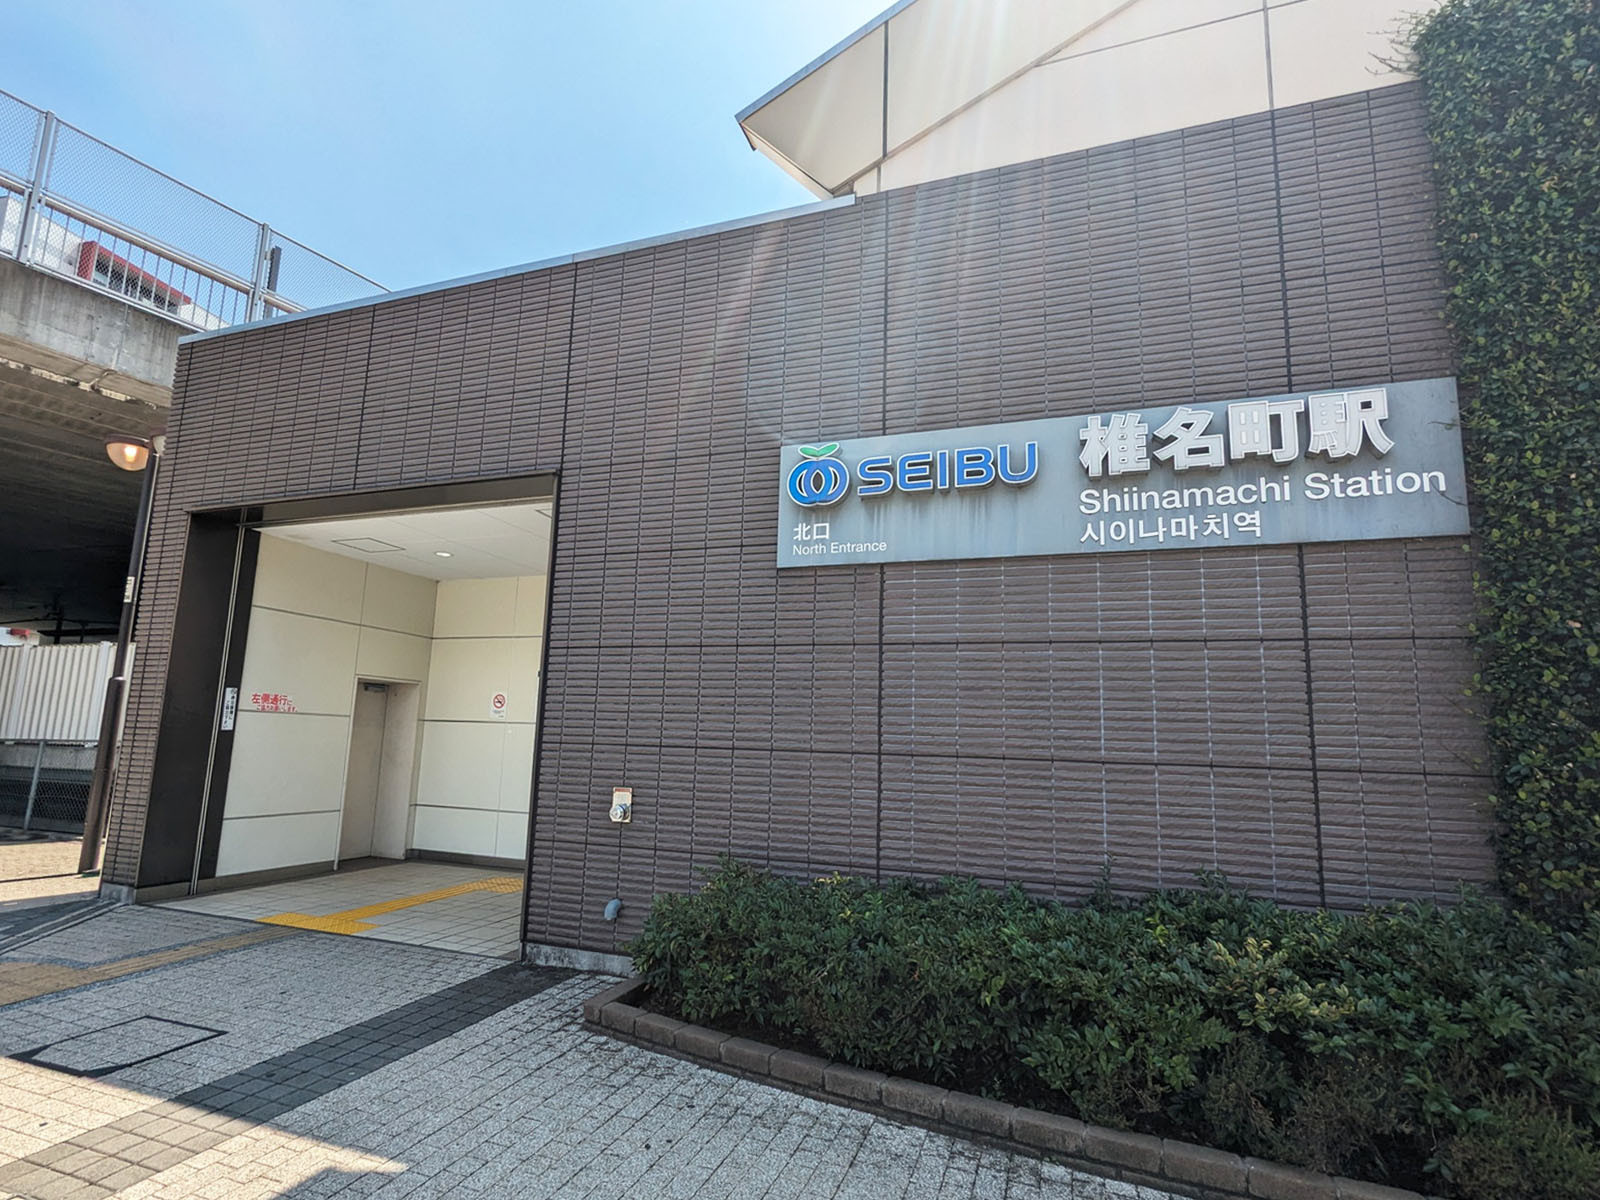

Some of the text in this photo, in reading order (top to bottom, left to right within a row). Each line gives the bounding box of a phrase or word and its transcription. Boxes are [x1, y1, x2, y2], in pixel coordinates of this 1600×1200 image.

[1079, 388, 1395, 479] 椎名町駅
[857, 441, 1038, 496] SEIBU
[1079, 467, 1447, 515] Shiinamachi Station
[792, 522, 830, 541] 北口
[792, 541, 888, 556] North Entrance
[1079, 510, 1262, 546] 시이나마치역
